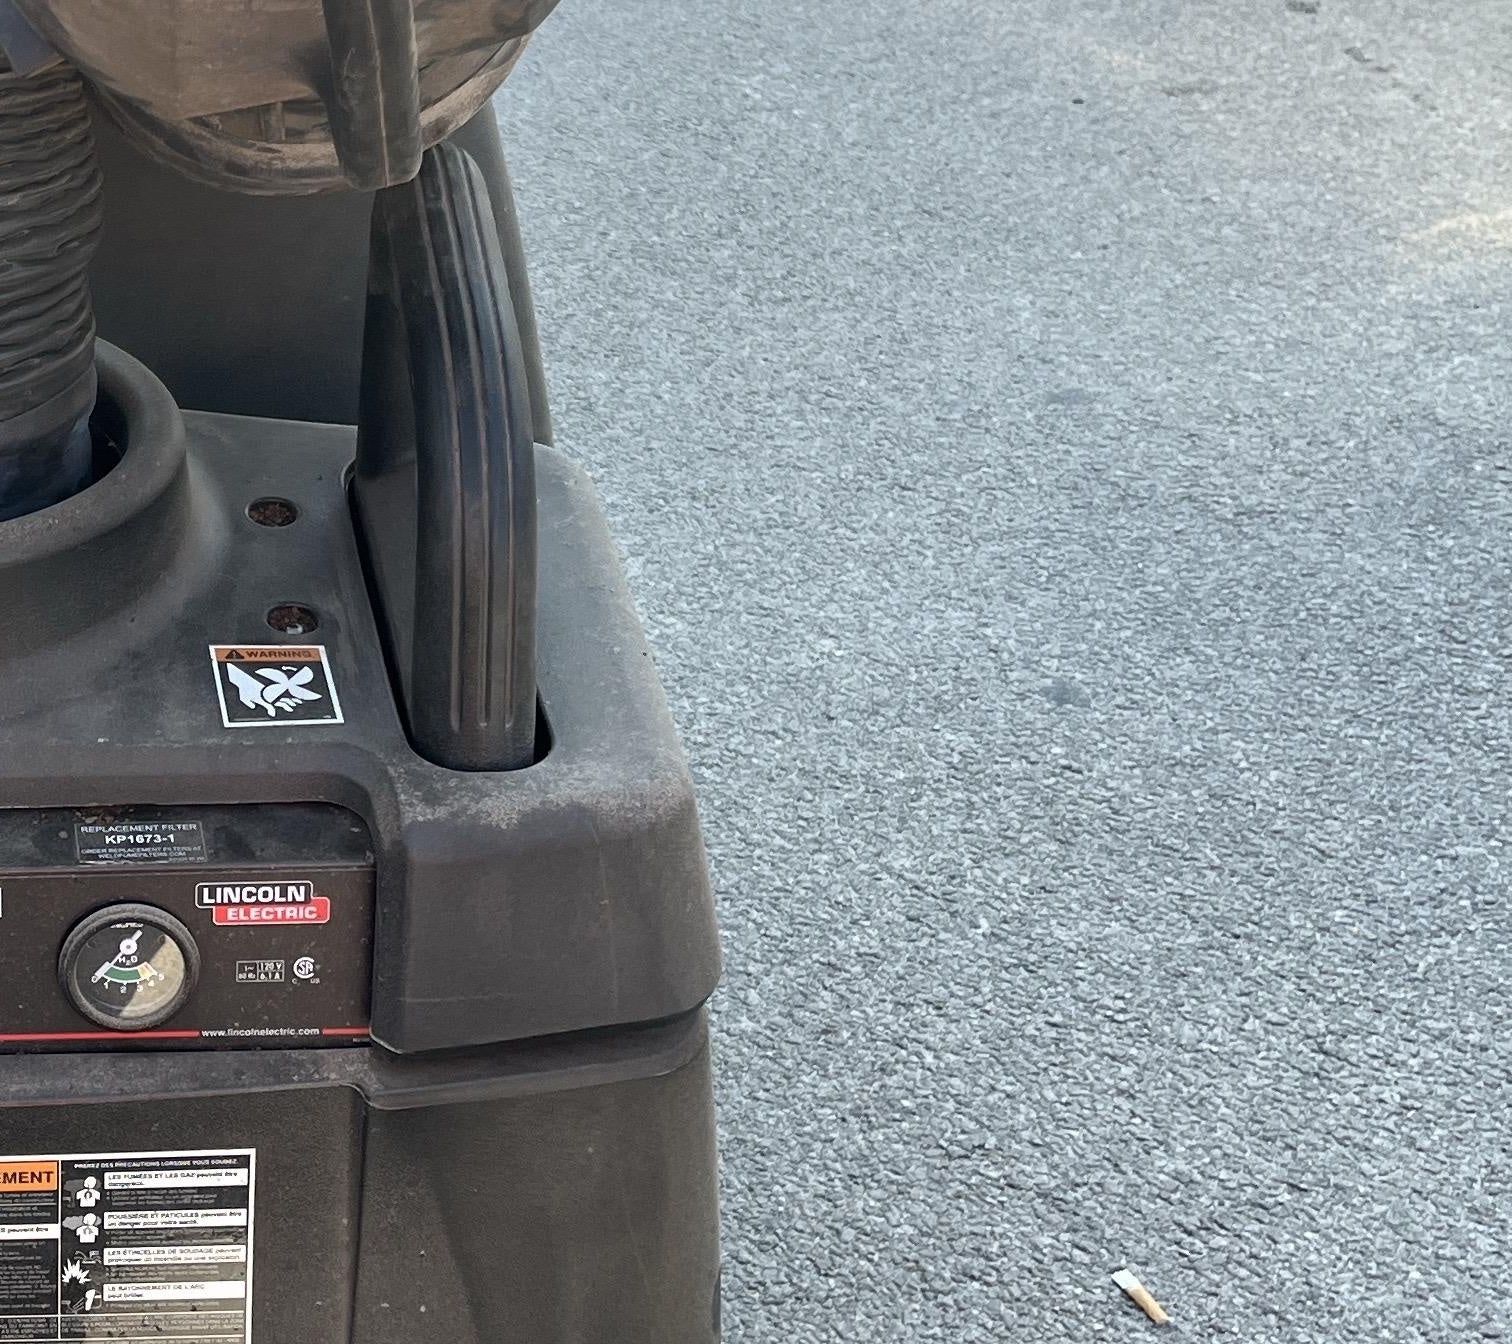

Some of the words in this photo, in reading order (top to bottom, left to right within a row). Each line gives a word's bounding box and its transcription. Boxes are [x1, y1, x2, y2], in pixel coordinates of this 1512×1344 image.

[245, 649, 312, 658] WARNING
[80, 824, 159, 833] REPLACEMENT
[105, 833, 175, 844] KP1673-1
[202, 885, 306, 904] LINCOLN
[227, 906, 318, 920] ELECTRIC
[202, 1028, 320, 1037] www.lincolnelectric.com
